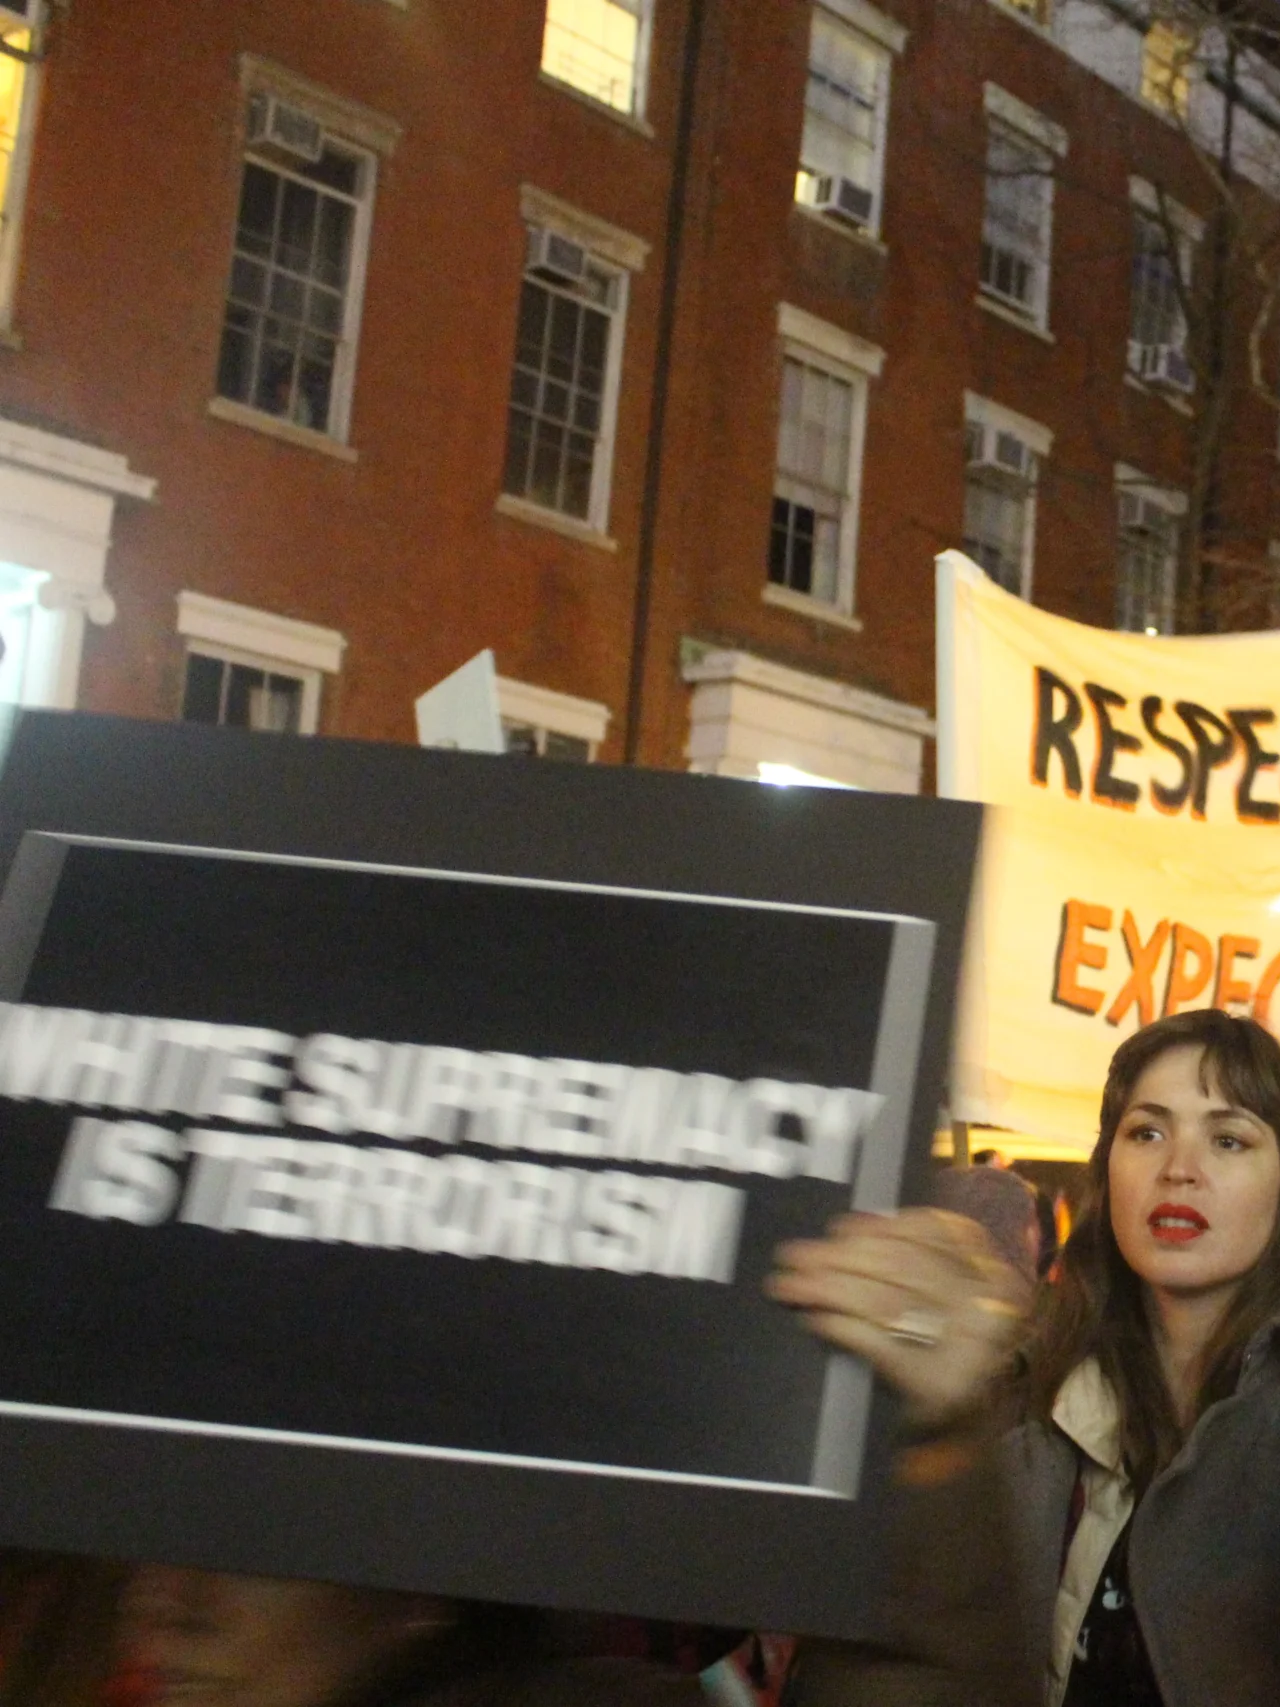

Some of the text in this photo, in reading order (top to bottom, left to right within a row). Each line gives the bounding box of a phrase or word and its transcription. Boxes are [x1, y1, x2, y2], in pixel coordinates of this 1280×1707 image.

[284, 1032, 886, 1184] SUPREMACY
[46, 1115, 747, 1285] IS TERRORISM
